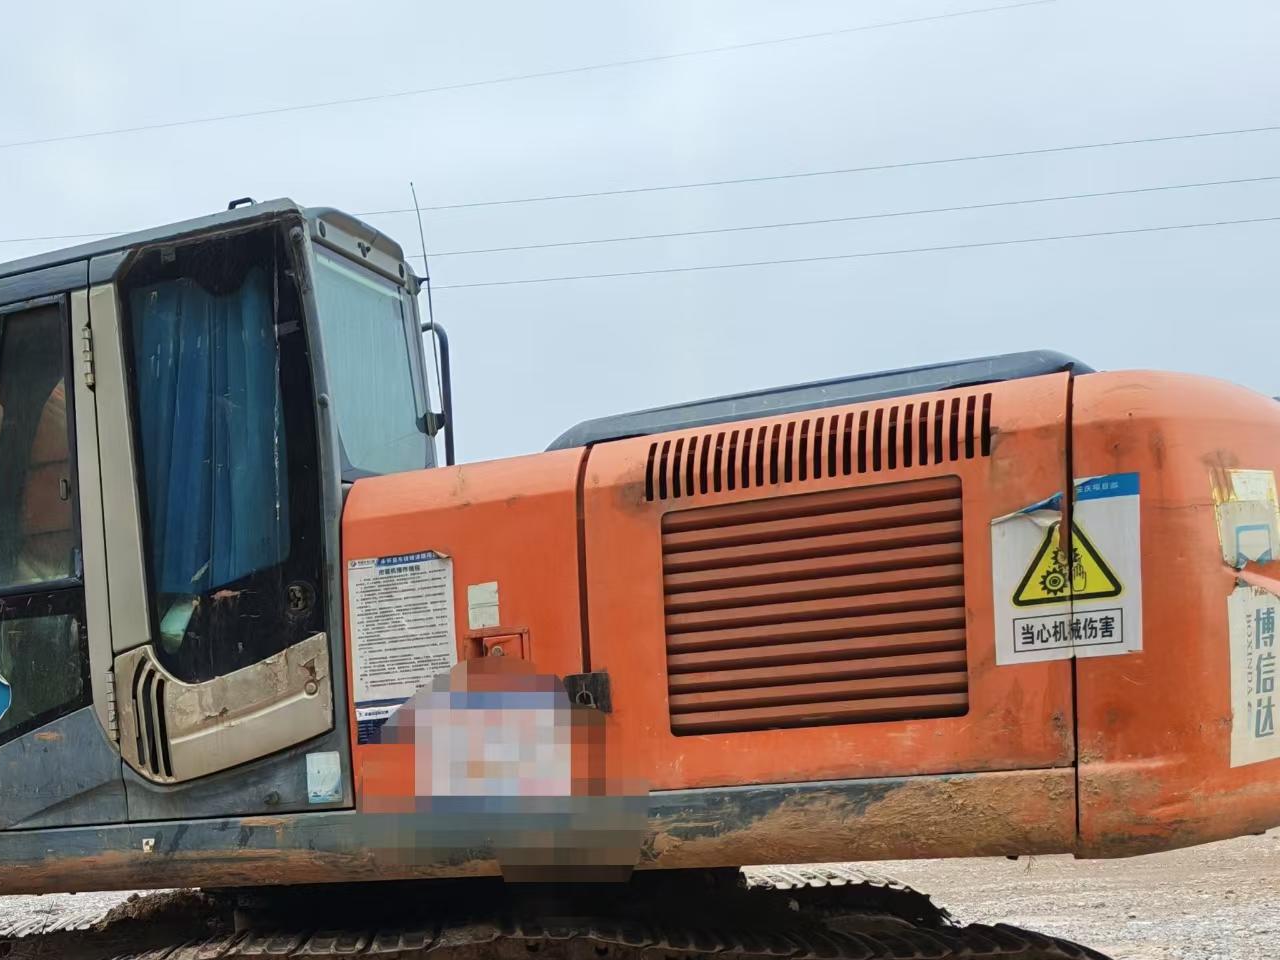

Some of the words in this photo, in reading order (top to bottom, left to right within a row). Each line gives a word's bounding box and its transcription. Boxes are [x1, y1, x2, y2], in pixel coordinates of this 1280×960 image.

[1021, 616, 1115, 645] 当心机械伤害
[1255, 607, 1276, 738] 博信达
